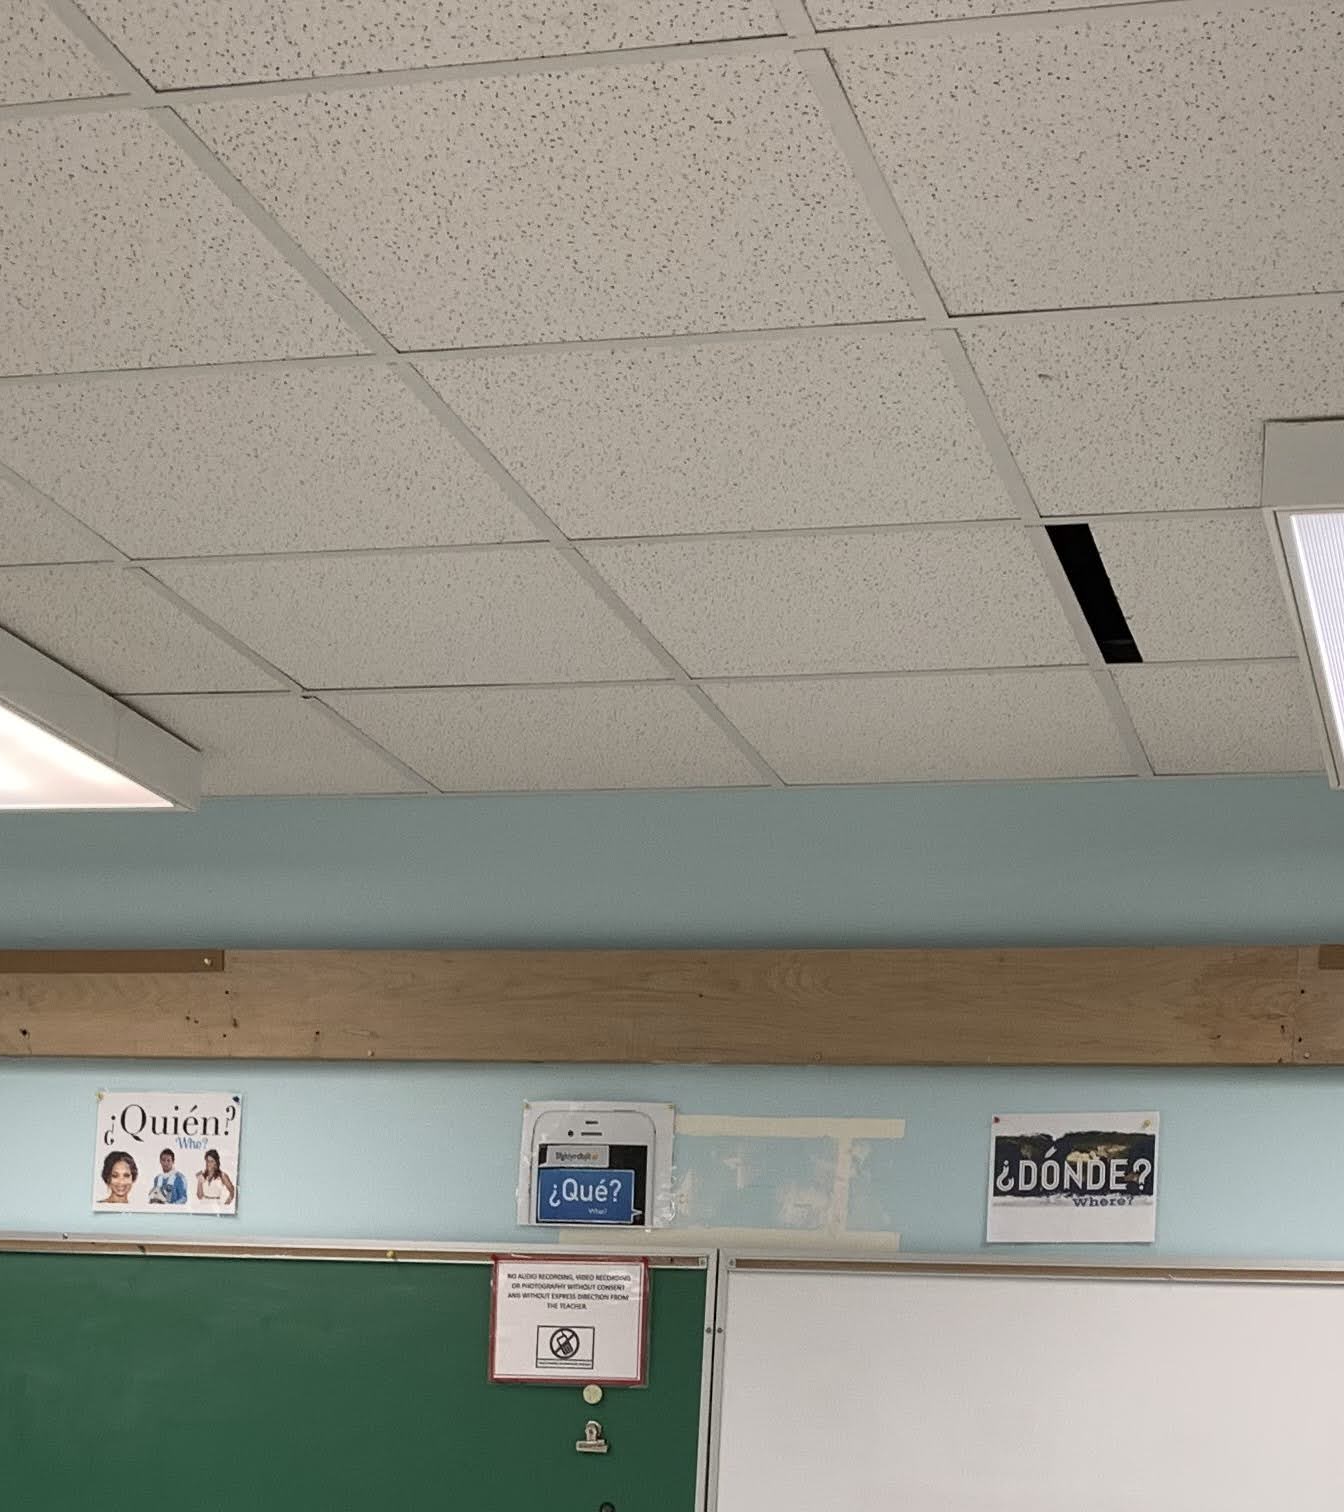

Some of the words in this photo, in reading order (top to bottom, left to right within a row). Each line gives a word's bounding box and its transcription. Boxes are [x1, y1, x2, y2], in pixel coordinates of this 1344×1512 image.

[104, 1103, 236, 1146] ¿Quién?
[175, 1137, 208, 1150] Who?
[996, 1146, 1152, 1192] ¿DÓNDE?
[549, 1177, 622, 1207] ¿Qué?
[1072, 1196, 1134, 1207] Where?
